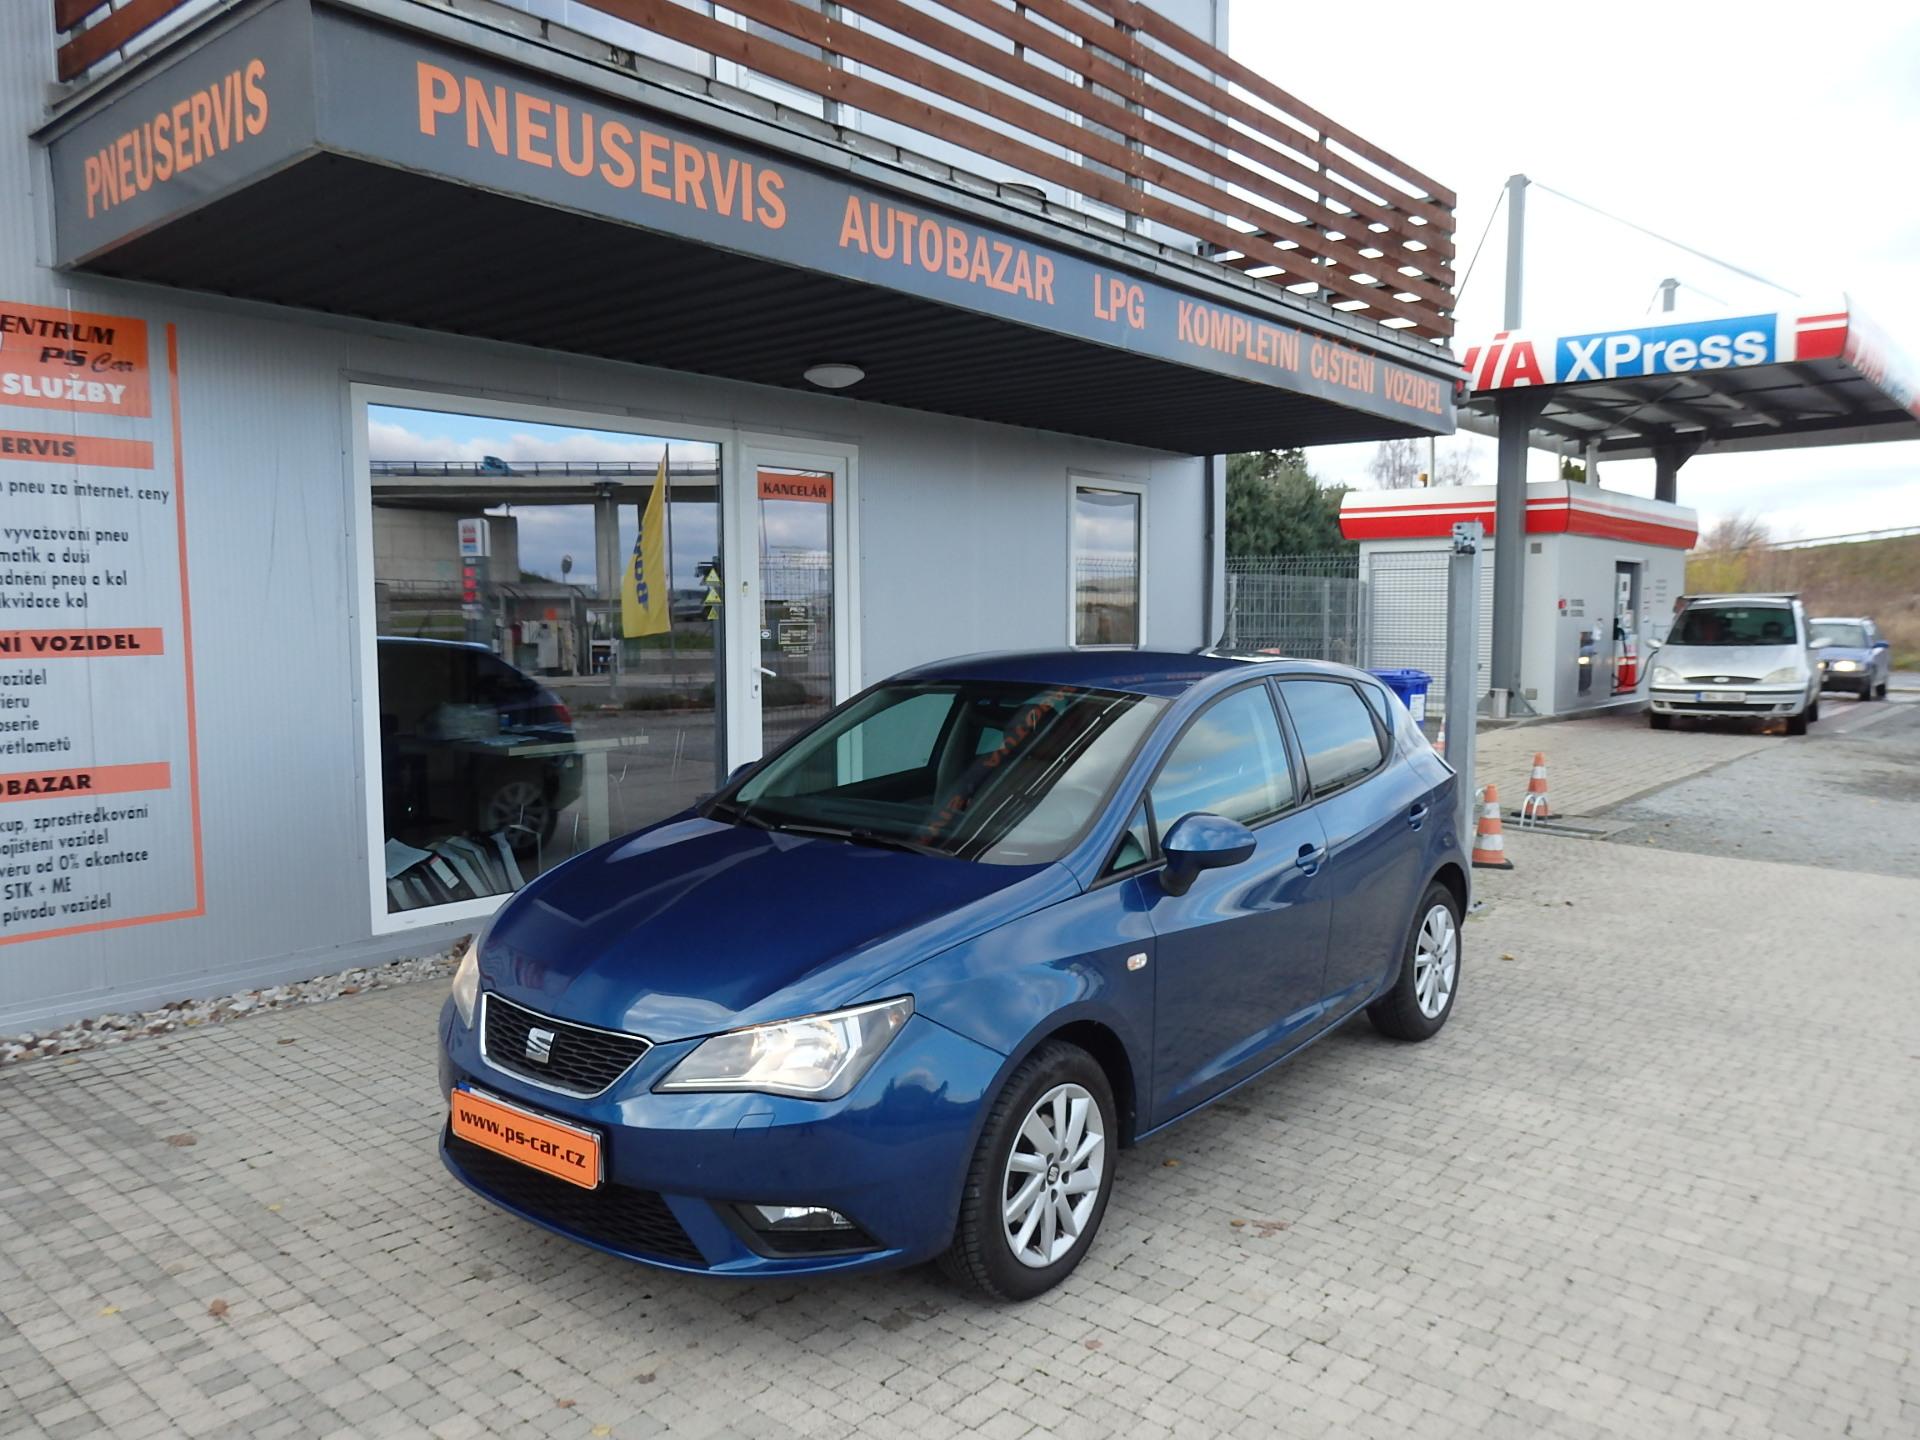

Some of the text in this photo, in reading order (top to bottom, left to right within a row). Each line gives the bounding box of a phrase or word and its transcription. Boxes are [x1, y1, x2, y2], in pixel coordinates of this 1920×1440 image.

[84, 57, 268, 220] PNEUSERVIS
[416, 60, 787, 230] PNEUSERVIS
[839, 195, 1055, 305] AUTOBAZAR
[1094, 273, 1145, 330] LPG
[1178, 299, 1301, 373] KOMPLETNÍ
[1384, 366, 1442, 415] VOZIDEL
[40, 346, 88, 367] PS
[1564, 331, 1768, 382] XPress
[2, 372, 126, 405] SLUŽBY
[9, 481, 45, 497] pneu
[73, 480, 133, 499] internet.
[137, 489, 169, 504] ceny
[763, 482, 827, 498] KANCELÁŘ
[95, 531, 129, 545] pneu
[47, 552, 56, 563] a
[52, 575, 87, 590] pneu
[92, 575, 101, 586] a
[105, 569, 128, 586] kol
[65, 591, 88, 608] kol
[30, 634, 140, 652] VOZIDEL
[58, 828, 109, 848] vozidel
[36, 856, 54, 873] od
[85, 851, 149, 868] akontace
[4, 881, 33, 900] STK
[52, 876, 72, 894] ME
[61, 893, 112, 914] vozidel
[459, 1109, 586, 1168] www.ps-car.cz
